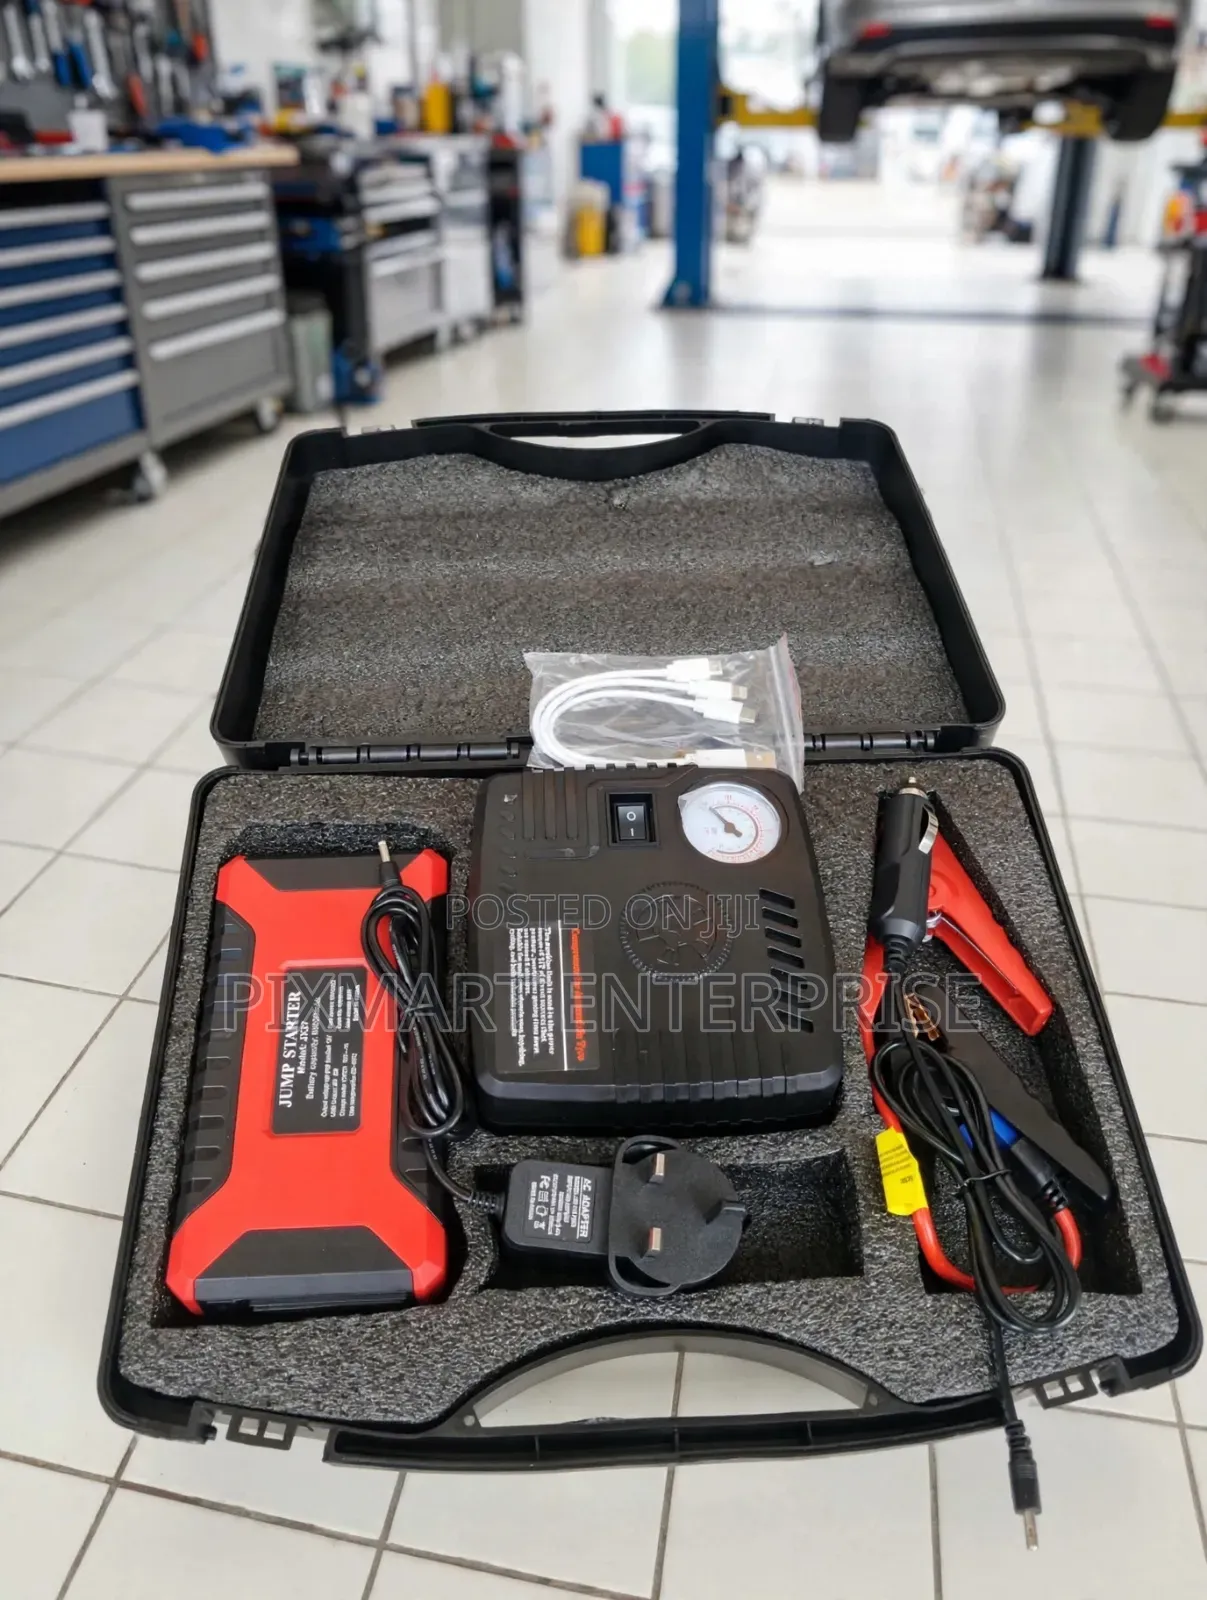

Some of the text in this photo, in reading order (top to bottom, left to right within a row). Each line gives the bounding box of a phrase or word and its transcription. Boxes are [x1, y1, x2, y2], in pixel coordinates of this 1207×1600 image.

[278, 991, 301, 1108] JUMP STARTER
[579, 1178, 592, 1238] AC ADAPTER
